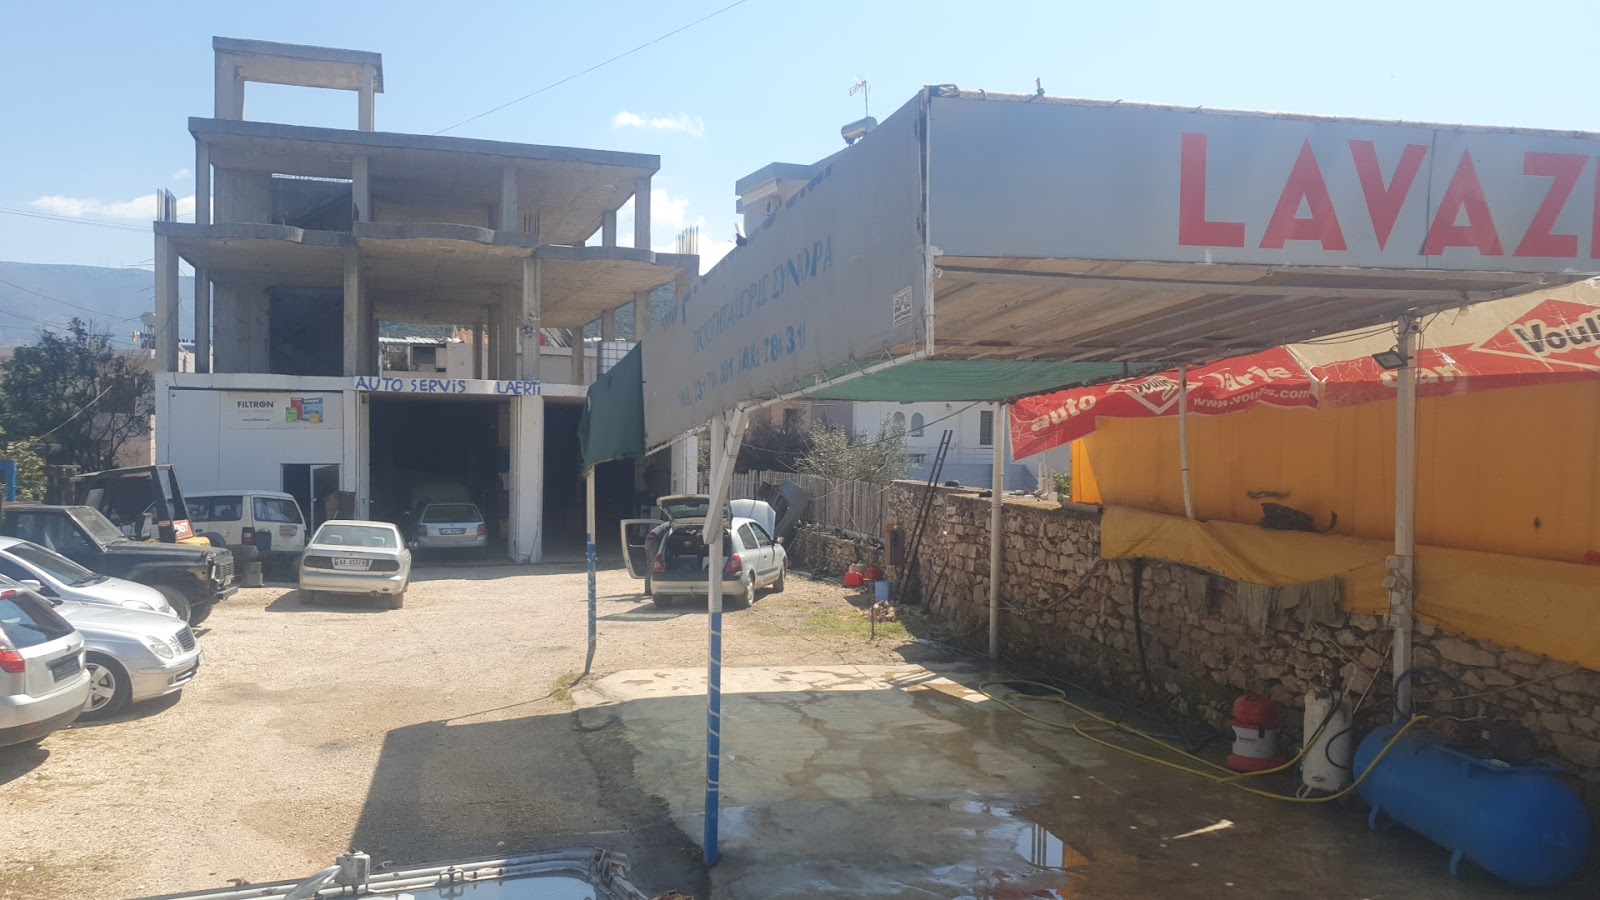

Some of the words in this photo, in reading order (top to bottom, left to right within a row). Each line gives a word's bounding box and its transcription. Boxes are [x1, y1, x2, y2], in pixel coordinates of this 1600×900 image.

[1178, 132, 1600, 259] LAVAZ
[1513, 313, 1600, 353] Voul
[355, 376, 403, 392] AUTO
[237, 400, 274, 408] FILTRON
[1031, 395, 1096, 432] auto
